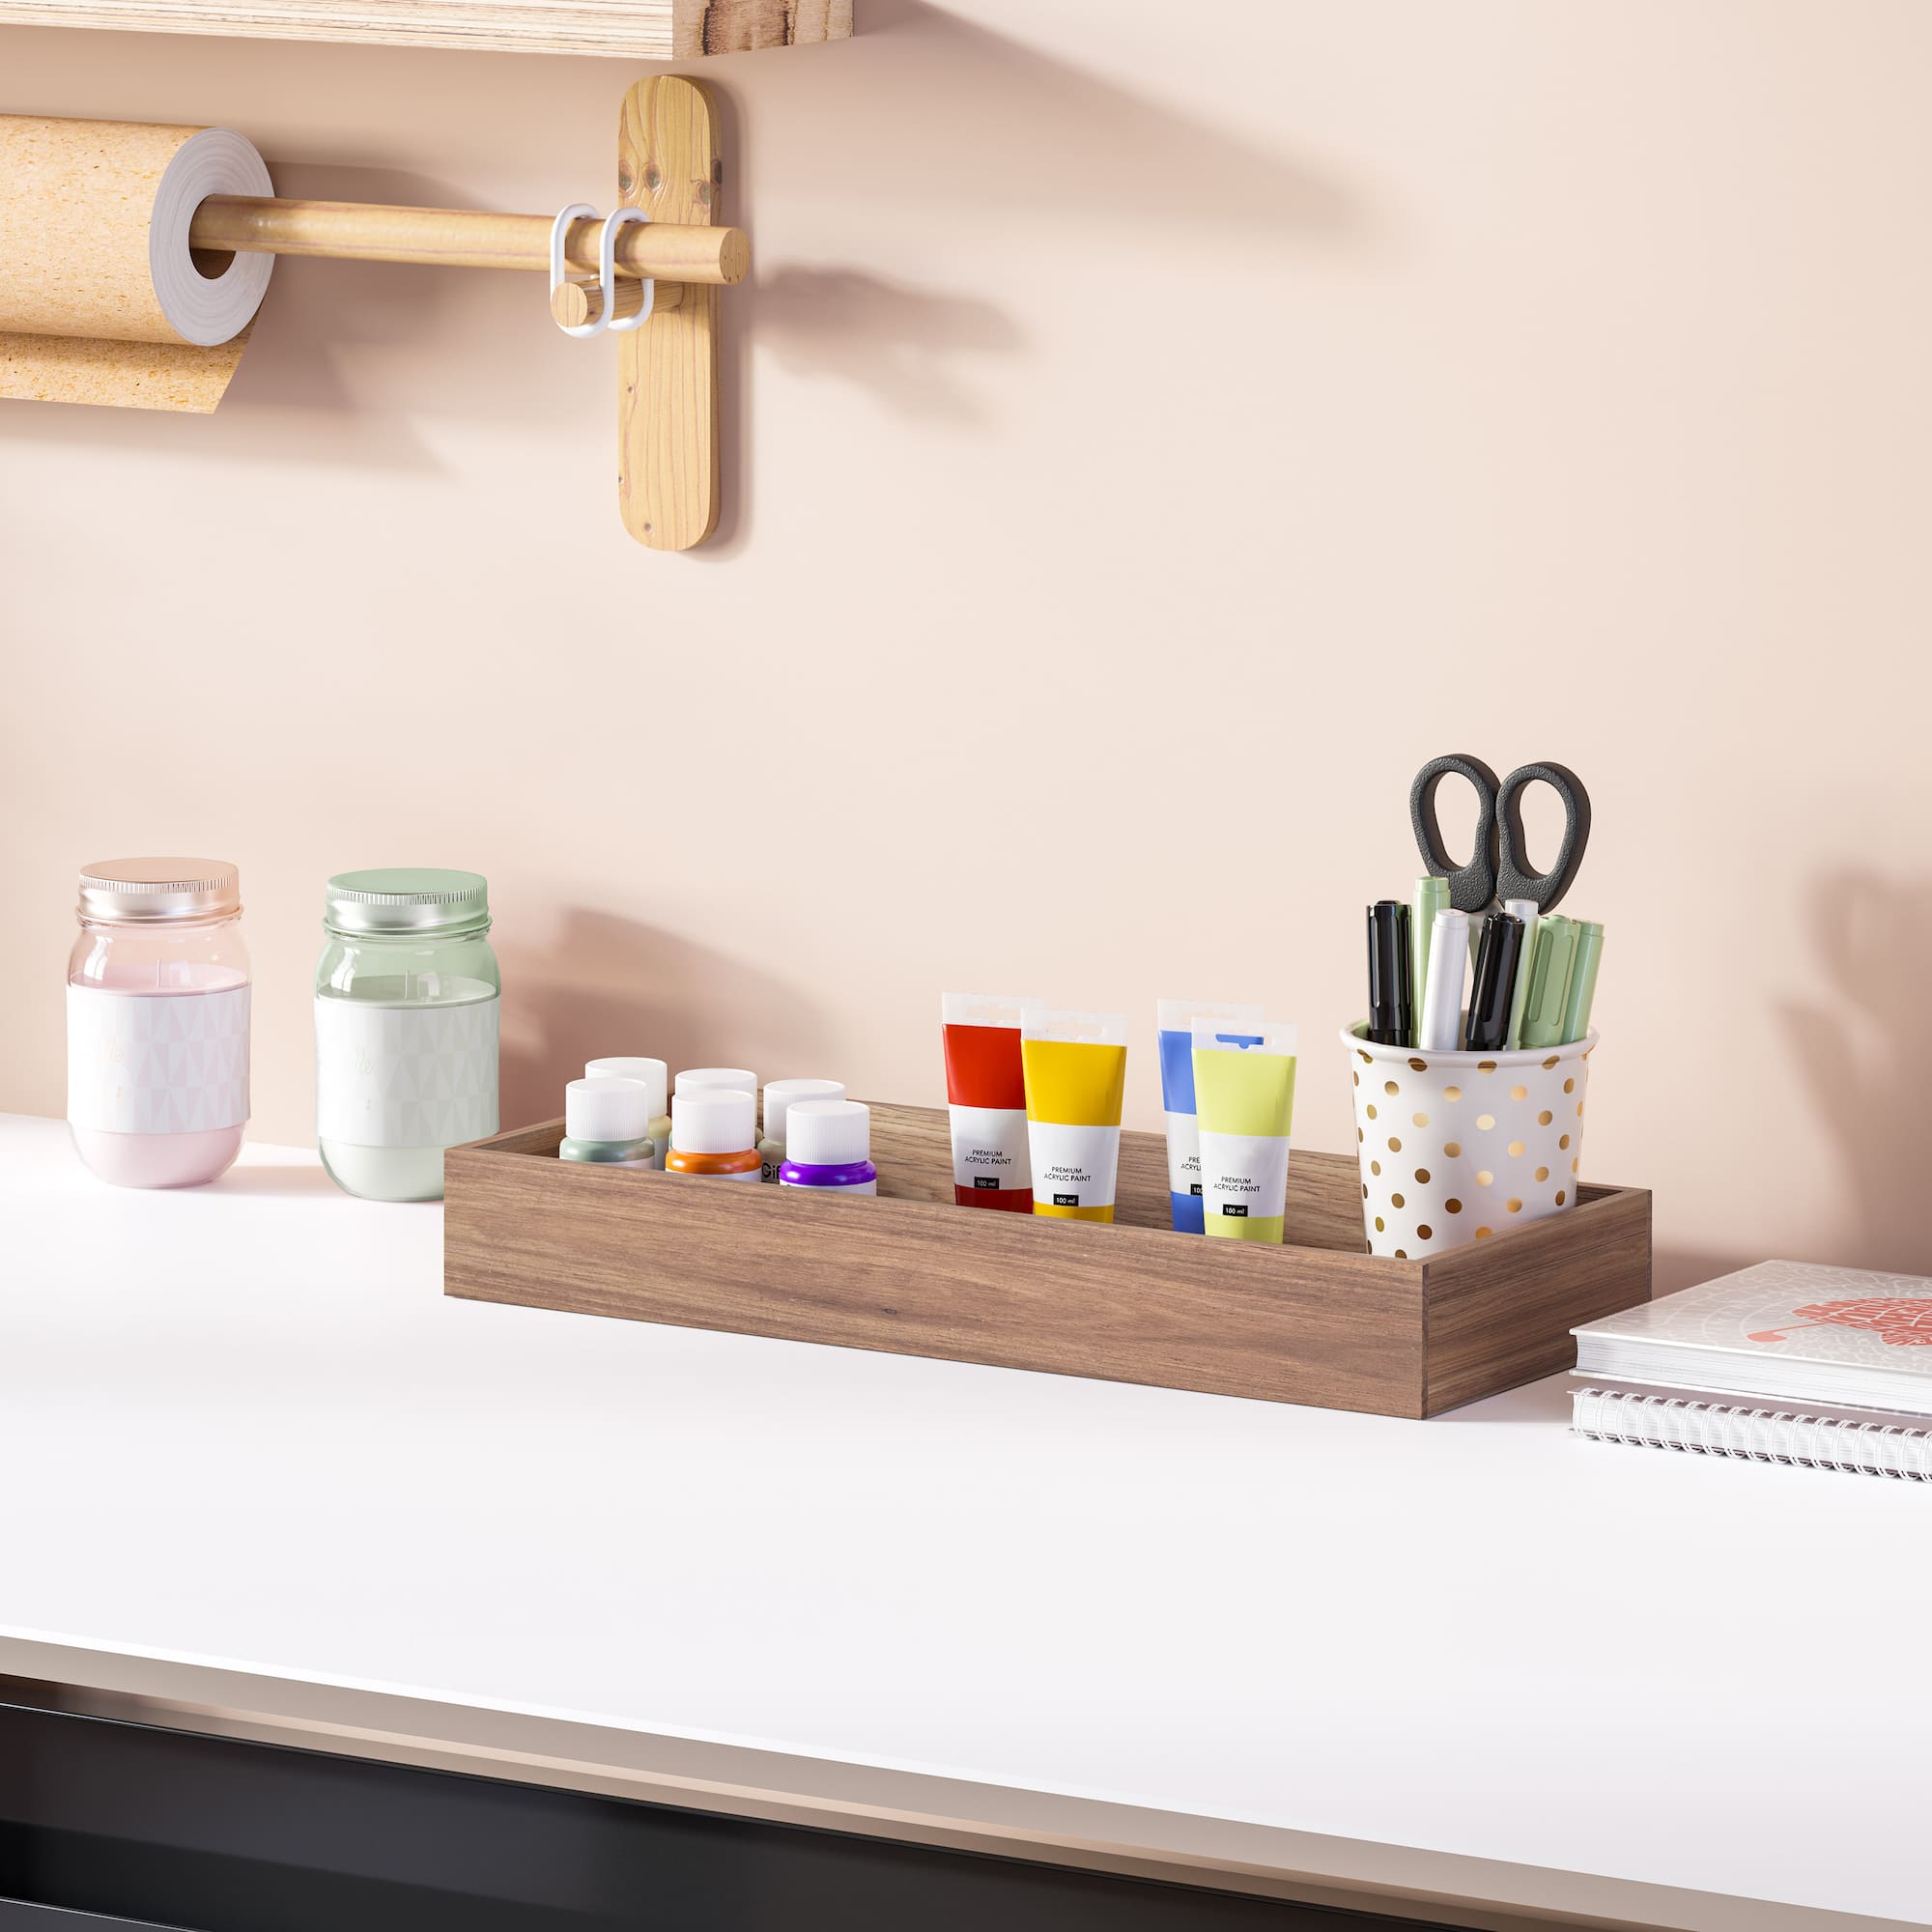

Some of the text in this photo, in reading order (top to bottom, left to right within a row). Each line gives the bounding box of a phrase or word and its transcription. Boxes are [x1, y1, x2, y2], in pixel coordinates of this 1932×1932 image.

[965, 1156, 990, 1165] ACRYLIC
[1221, 1176, 1252, 1184] PREMIUM
[1213, 1182, 1238, 1192] ACRYLIC
